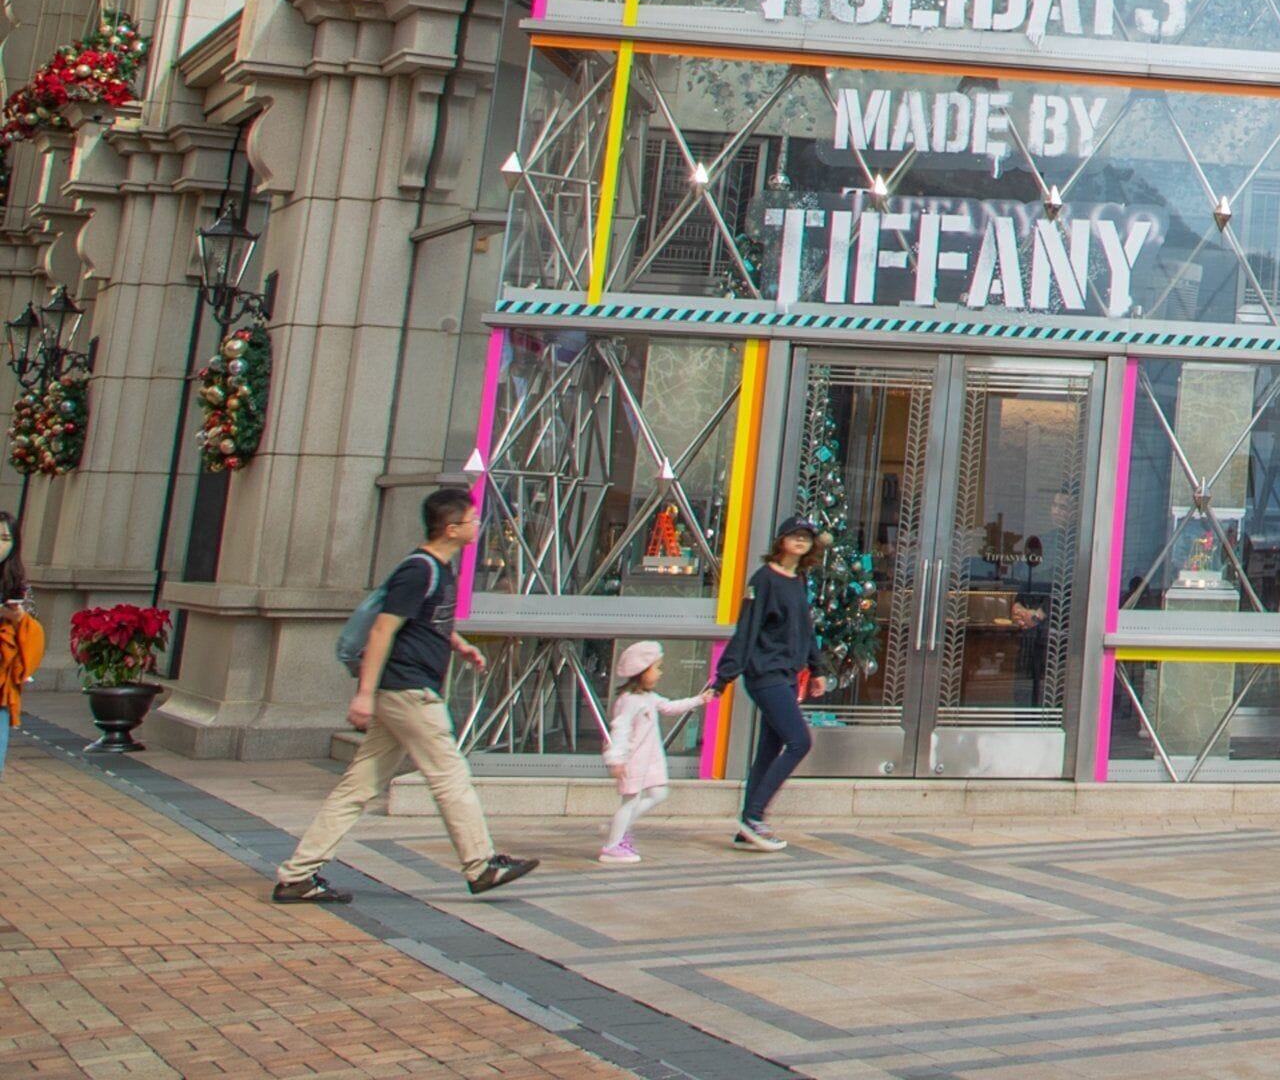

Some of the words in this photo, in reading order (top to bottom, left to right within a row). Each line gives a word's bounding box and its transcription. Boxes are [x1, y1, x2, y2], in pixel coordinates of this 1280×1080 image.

[835, 88, 1011, 156] MADE
[1027, 94, 1108, 156] BY
[765, 207, 1152, 318] TIFFANY
